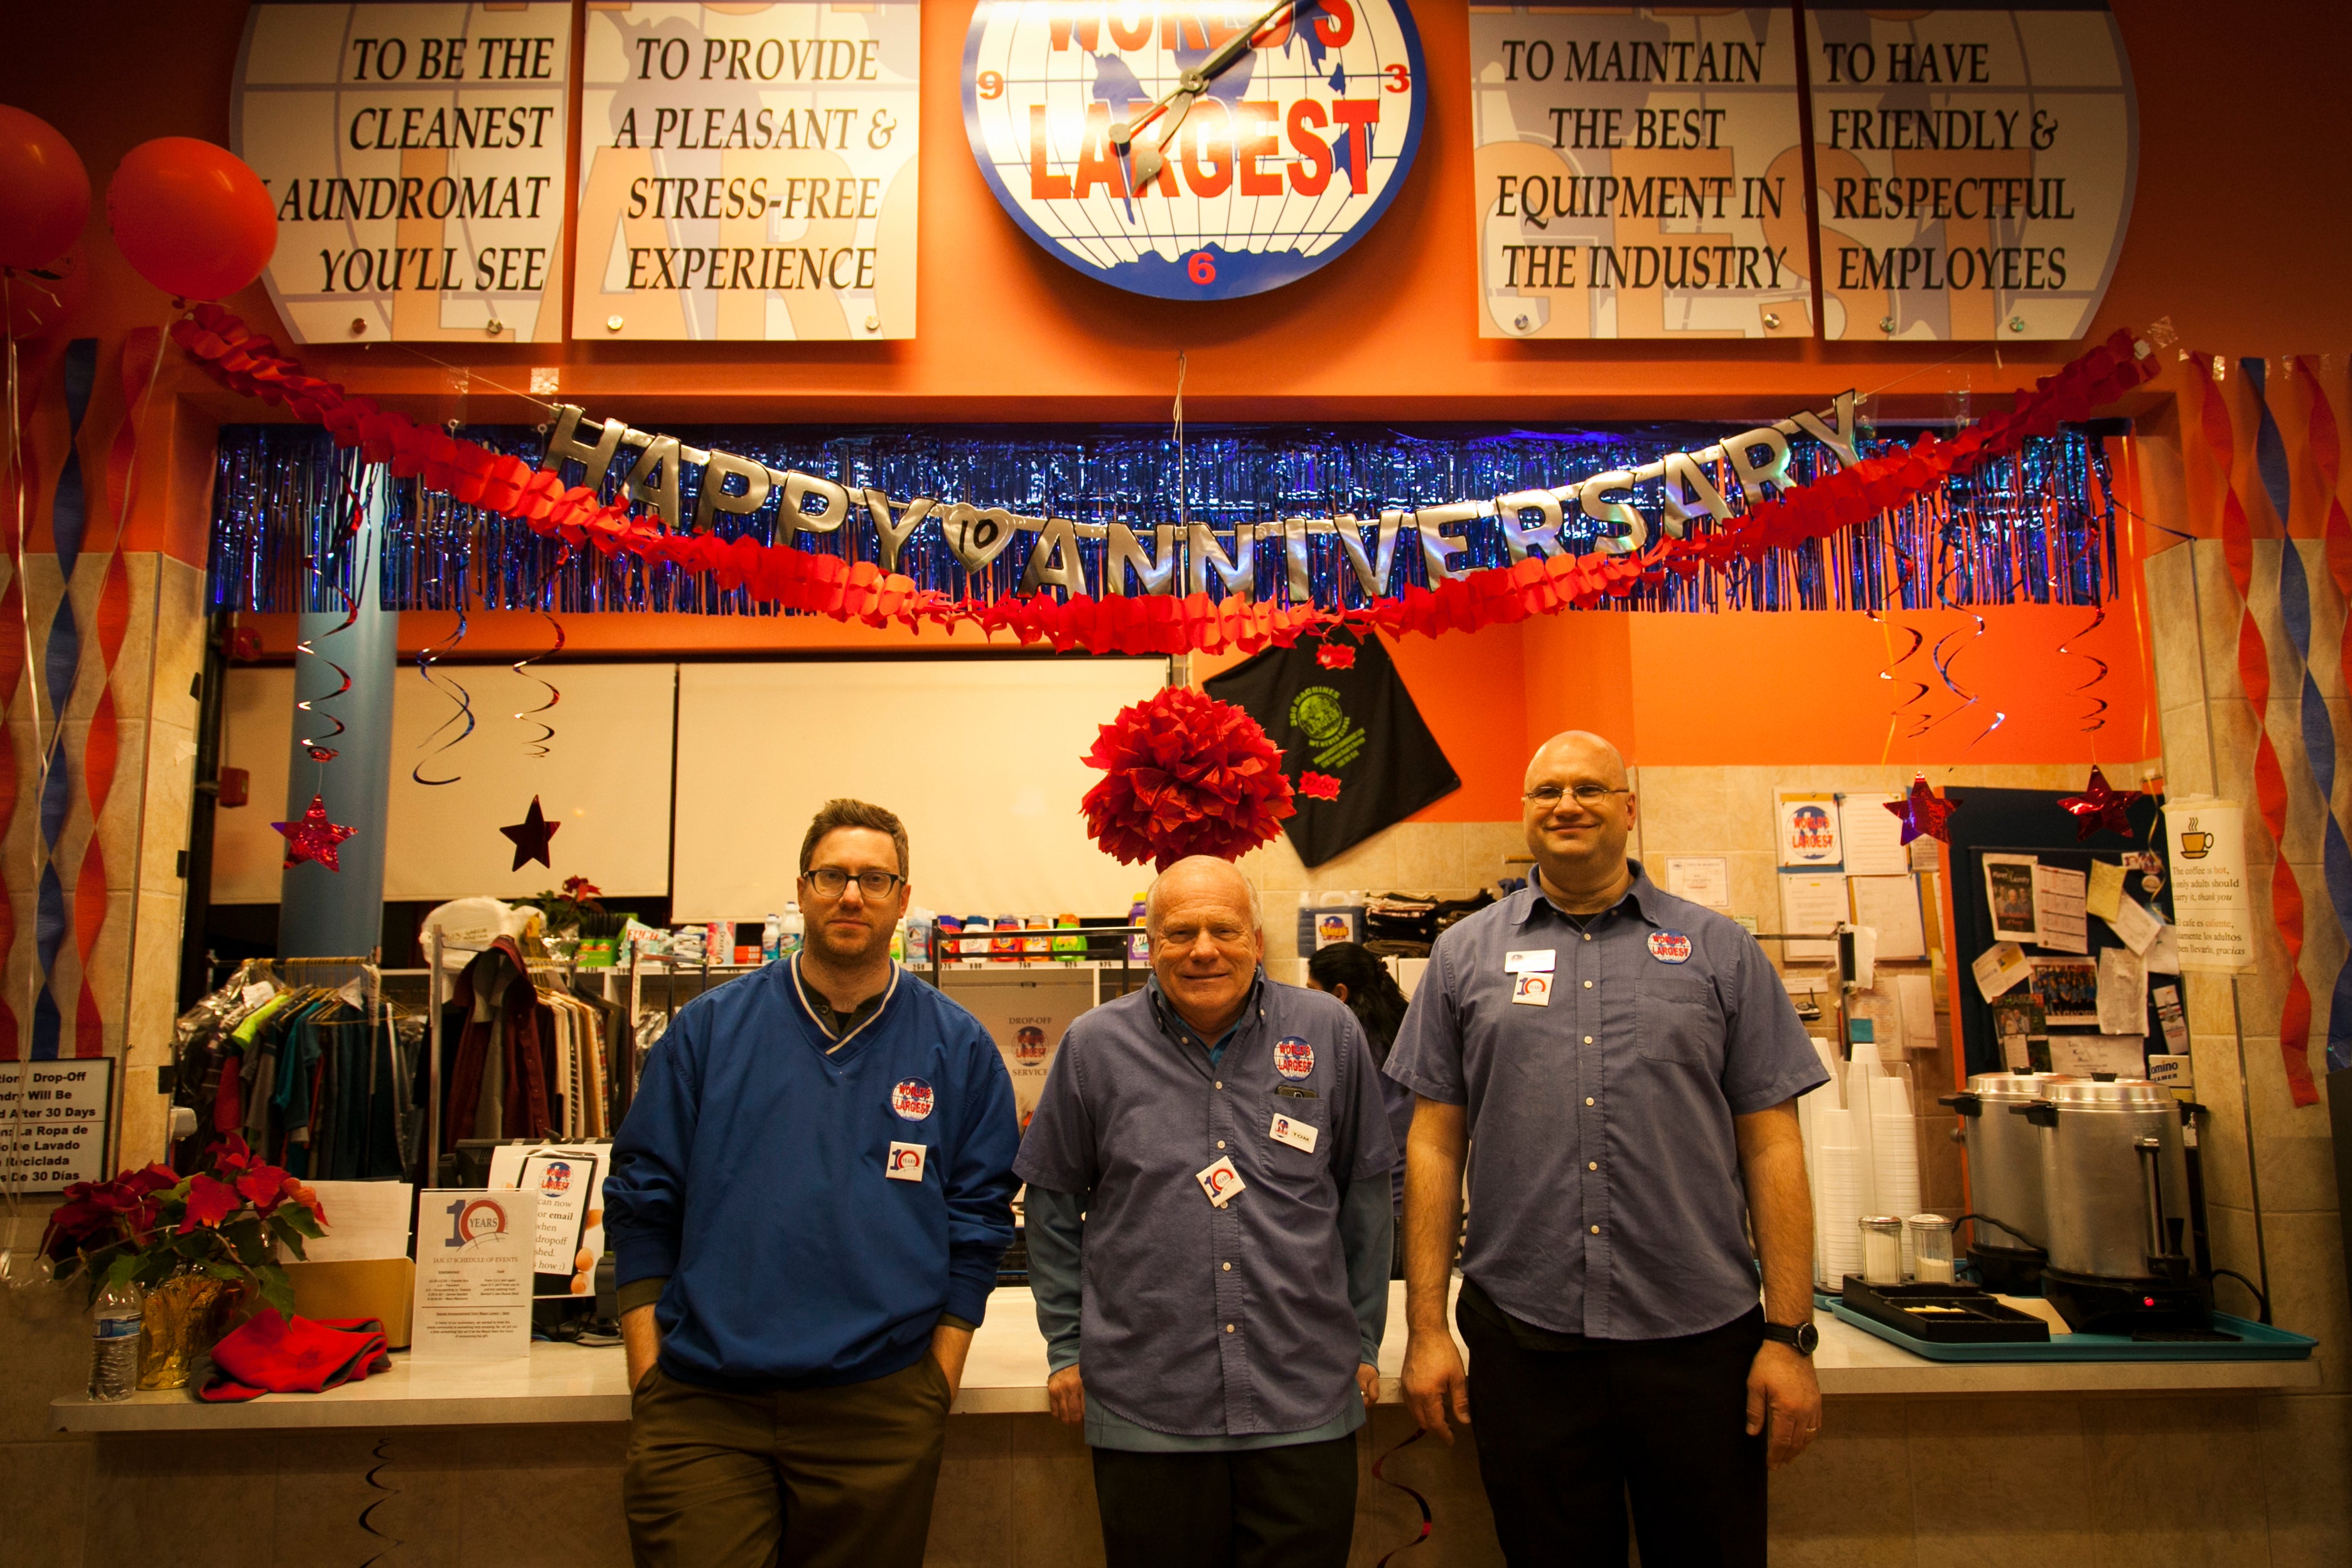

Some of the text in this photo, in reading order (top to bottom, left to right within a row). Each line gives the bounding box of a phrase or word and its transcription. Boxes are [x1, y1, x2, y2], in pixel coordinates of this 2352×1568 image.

[353, 38, 554, 80] TO BE THE
[636, 38, 879, 80] TO PROVIDE
[1502, 40, 1765, 83] TO MAINTAIN
[1823, 43, 1990, 83] TO HAVE
[977, 70, 1004, 99] 9
[1385, 64, 1410, 93] 3
[350, 107, 553, 149] CLEANEST
[611, 107, 897, 150] A PLEASANT &
[1549, 108, 1726, 149] THE BEST
[1828, 109, 2058, 150] FRIENDLY &
[1029, 99, 1379, 200] LARGEST
[262, 176, 550, 222] AUNDROMAT
[628, 178, 880, 220] STRESS-FREE
[1496, 175, 1785, 230] EQUIPMENT IN
[1833, 178, 2075, 220] RESPECTFUL
[320, 248, 545, 293] YOU'LL SEE
[626, 248, 877, 290] EXPERIENCE
[1188, 252, 1215, 284] 6
[1502, 245, 1787, 289] THE INDUSTRY
[1838, 247, 2066, 290] EMPLOYEES
[540, 389, 1861, 604] HAPPY 10 ANNIVERSARY
[1792, 834, 1833, 848] LARGEST
[2172, 867, 2183, 875] The
[2185, 866, 2204, 874] coffee
[2176, 880, 2188, 889] only
[2191, 879, 2210, 888] adults
[2211, 879, 2239, 888] should
[2198, 893, 2215, 901] thank
[2214, 933, 2242, 941] adultos
[1652, 946, 1689, 957] LARGEST
[2216, 947, 2245, 956] gracias
[1279, 1043, 1310, 1056] WORLD'S
[1277, 1060, 1312, 1073] LARGEST
[2151, 1062, 2178, 1074] omino
[33, 1071, 87, 1084] Drop-Off
[28, 1090, 51, 1100] Will
[56, 1090, 72, 1100] Be
[899, 1084, 931, 1099] WORLD'S
[10, 1109, 42, 1119] Ater
[46, 1108, 61, 1117] 30
[65, 1107, 95, 1119] Days
[896, 1099, 930, 1115] LARGEST
[37, 1126, 68, 1137] Ropa
[73, 1125, 88, 1134] de
[1293, 1132, 1310, 1142] TOM
[35, 1141, 80, 1151] Lavado
[32, 1171, 48, 1181] 30
[52, 1170, 80, 1181] Días
[542, 1179, 569, 1191] LARGEST
[470, 1218, 498, 1228] YEARS
[549, 1212, 574, 1220] email
[535, 1235, 568, 1246] dropoff
[539, 1261, 557, 1269] how
